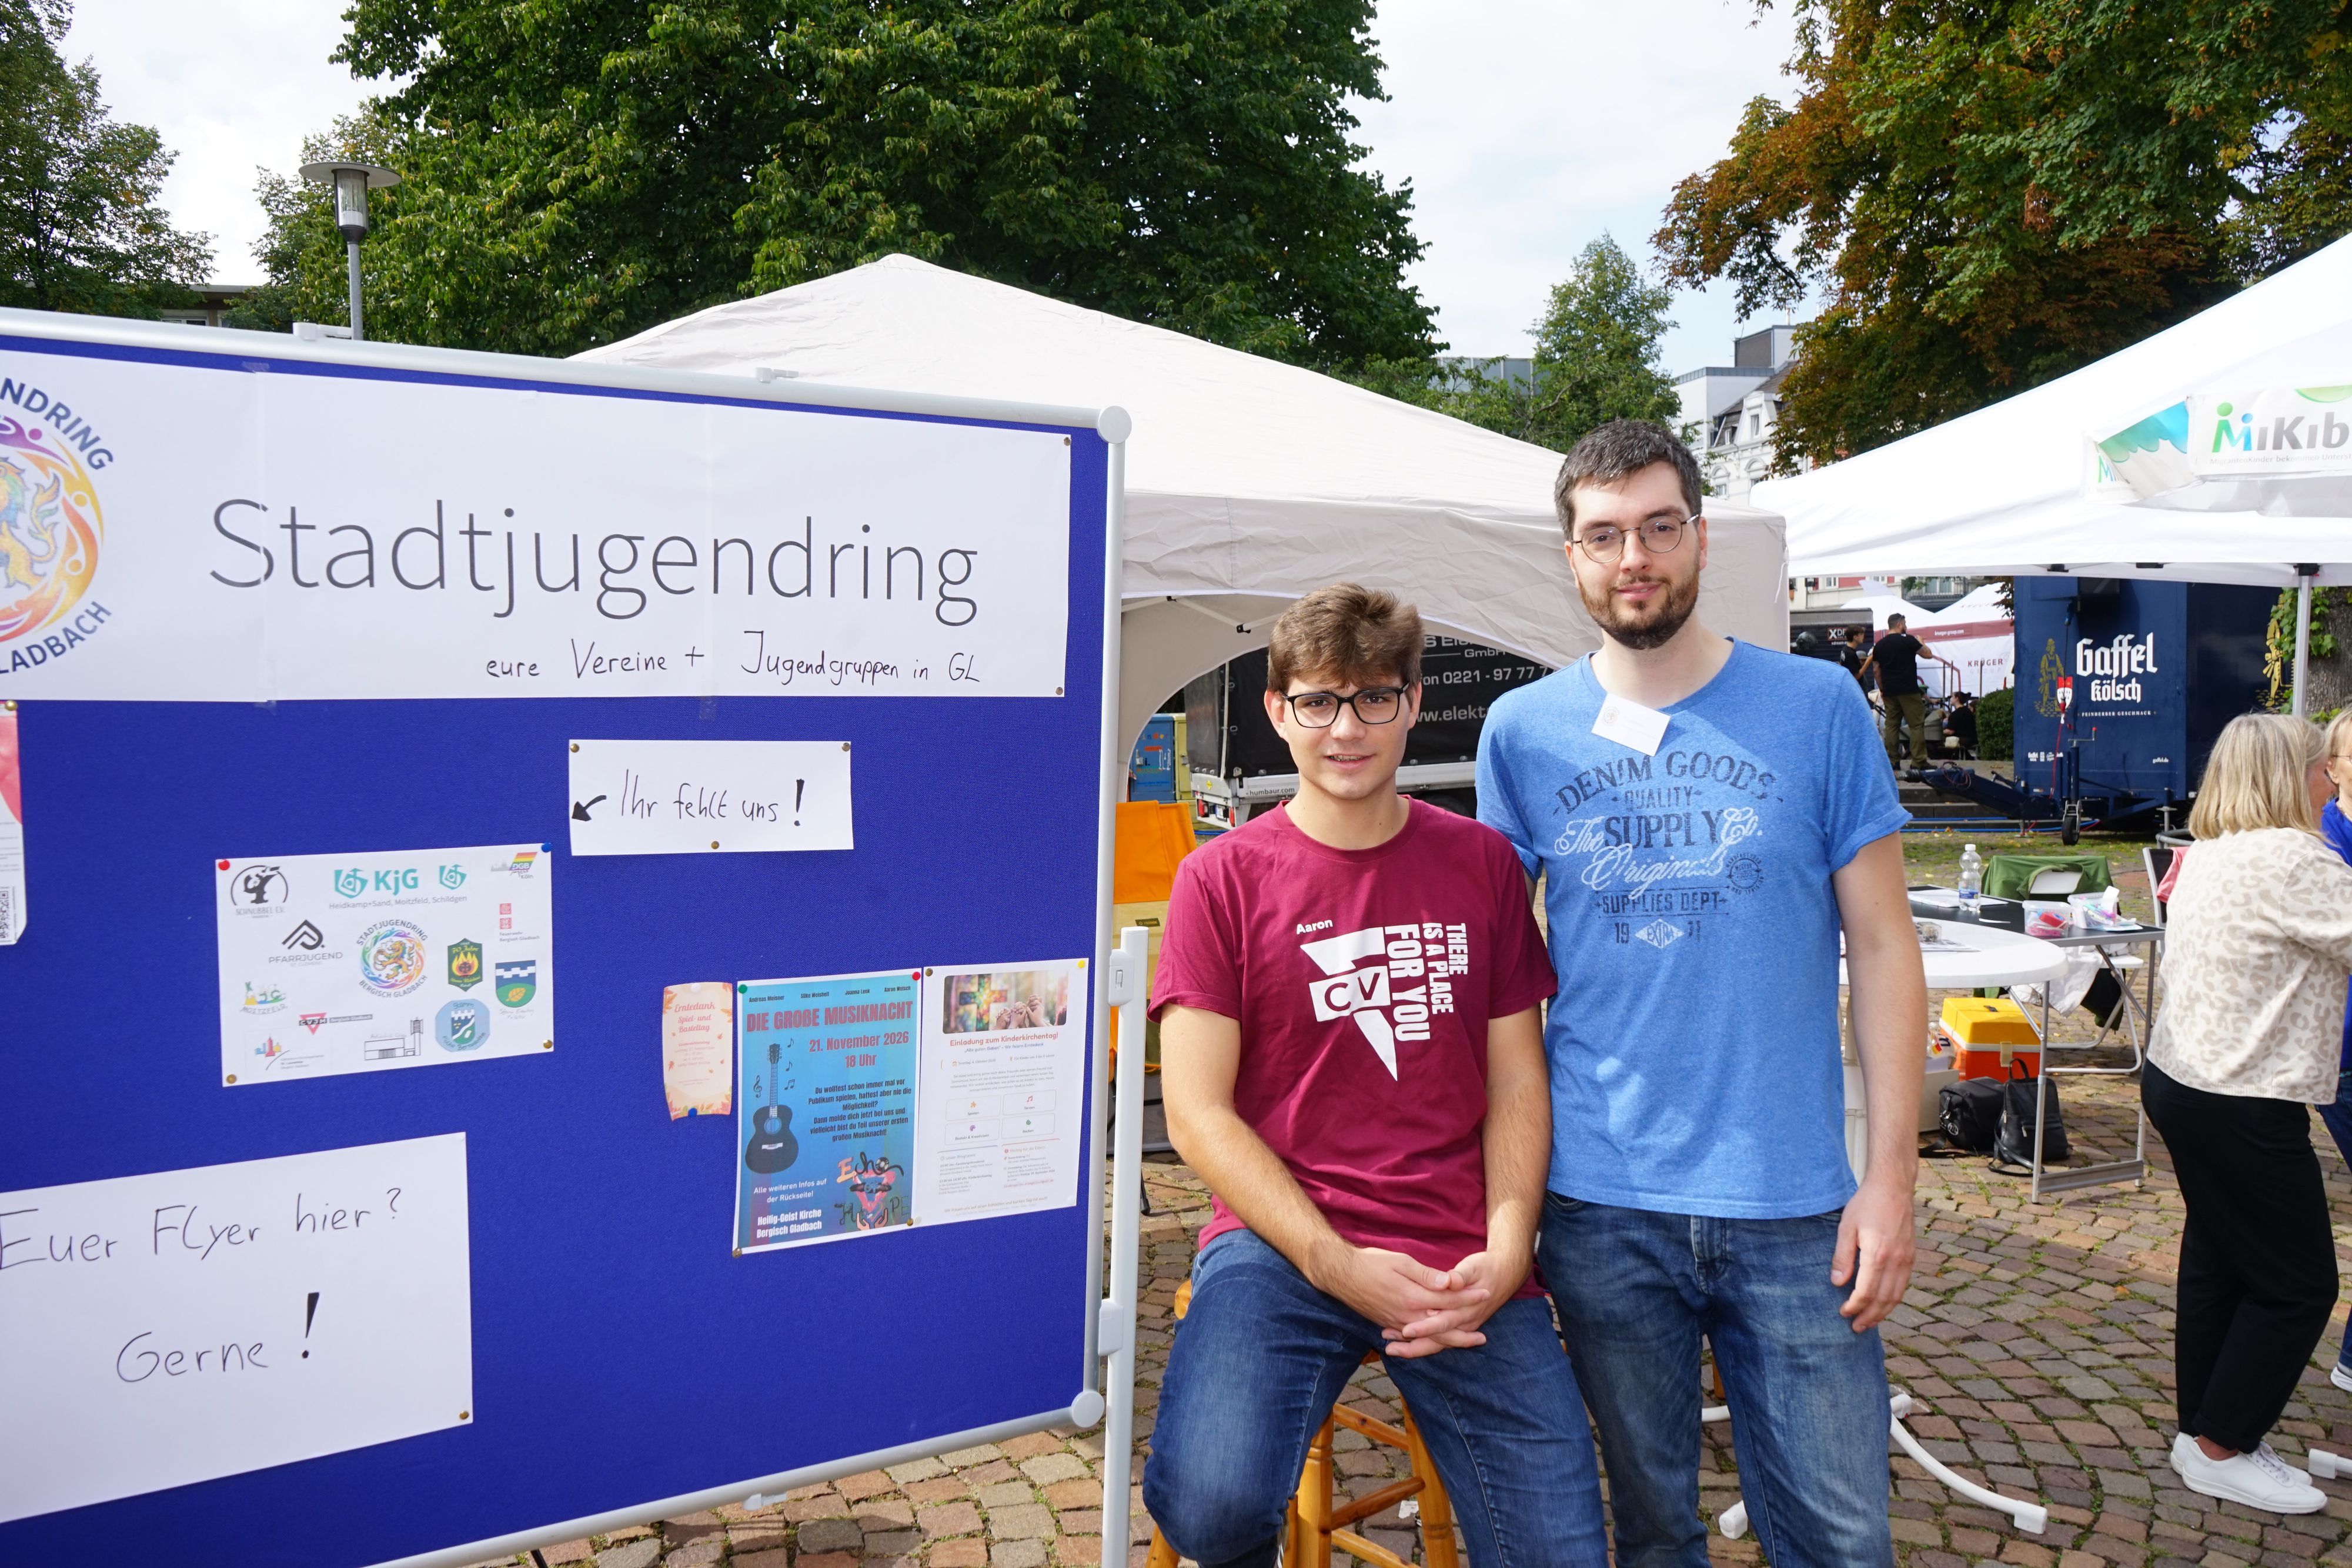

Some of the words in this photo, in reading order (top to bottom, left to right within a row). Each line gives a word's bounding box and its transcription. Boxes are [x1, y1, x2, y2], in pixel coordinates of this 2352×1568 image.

[210, 499, 978, 626] Stadtjugendring
[486, 657, 540, 678] eure
[570, 638, 668, 678] Vereine
[743, 630, 898, 686] Jugendgruppen
[913, 659, 928, 681] in
[948, 652, 980, 683] GL
[1968, 657, 2003, 667] KRÜGER
[2076, 632, 2158, 678] Gaffel
[1443, 670, 1481, 684] 0221
[1493, 668, 1511, 681] 97
[1516, 666, 1535, 679] 77
[1250, 787, 1295, 796] humbaur.com
[1555, 755, 1652, 814] DENIM
[1665, 750, 1777, 801] GOODS
[621, 768, 658, 819] Ihr
[674, 783, 727, 821] fehlt
[742, 797, 779, 823] uns
[1623, 786, 1696, 813] QUALITY
[1555, 815, 1606, 856] The
[1605, 810, 1725, 850] SUPPLY
[375, 868, 419, 896] KjG
[395, 897, 430, 907] Moitzfeld,
[432, 895, 467, 905] Schildgen
[1602, 895, 1673, 914] SUPPLIES
[1681, 891, 1720, 911] DEPT
[356, 919, 428, 946] STADTJUGENDRING
[1296, 919, 1333, 935] Aaron
[1422, 922, 1442, 940] IS
[268, 951, 343, 964] PFARRJUGEND
[1385, 924, 1425, 979] FOR
[1425, 944, 1445, 957] A
[1446, 922, 1468, 975] THERE
[359, 979, 392, 998] BERGISCH
[393, 974, 428, 998] GLADBACH
[1428, 961, 1454, 1015] PLACE
[674, 1002, 716, 1013] Erntedank
[746, 1012, 769, 1032] DIE
[824, 1001, 913, 1026] MUSIKNACHT
[1392, 984, 1431, 1042] YOU
[809, 1039, 823, 1052] 21.
[827, 1034, 881, 1051] November
[883, 1031, 909, 1045] 2026
[950, 1038, 984, 1047] Einladung
[1001, 1032, 1058, 1043] Kinderkirchentag!
[845, 1055, 856, 1068] 18
[859, 1053, 877, 1066] Uhr
[808, 1095, 834, 1105] Publikum
[836, 1094, 857, 1103] spielen,
[858, 1090, 878, 1099] hattest
[879, 1089, 892, 1097] aber
[824, 1084, 847, 1094] wolltest
[847, 1082, 865, 1091] schon
[866, 1081, 884, 1089] immer
[842, 1100, 878, 1111] Möglichkeit?
[813, 1116, 827, 1125] Dann
[828, 1114, 847, 1122] melde
[847, 1112, 860, 1120] dich
[860, 1110, 873, 1119] jetzt
[895, 1106, 906, 1115] und
[810, 1124, 836, 1135] vielleicht
[837, 1122, 848, 1132] bist
[849, 1122, 856, 1130] du
[857, 1120, 867, 1129] Teil
[868, 1118, 890, 1128] unserer
[890, 1116, 909, 1125] ersten
[832, 1132, 852, 1142] großen
[853, 1128, 887, 1139] Musiknacht!
[754, 1186, 767, 1194] Alle
[768, 1182, 798, 1192] weiteren
[799, 1180, 815, 1189] Infos
[816, 1178, 827, 1186] auf
[766, 1195, 779, 1204] der
[779, 1190, 814, 1202] Rückseite!
[757, 1211, 799, 1226] Heilig-Geist
[799, 1208, 822, 1221] Kirche
[0, 1209, 118, 1270] Euer
[154, 1205, 260, 1261] Flyer
[756, 1223, 789, 1239] Bergisch
[789, 1219, 822, 1233] Gladbach
[117, 1331, 269, 1382] Gerne
